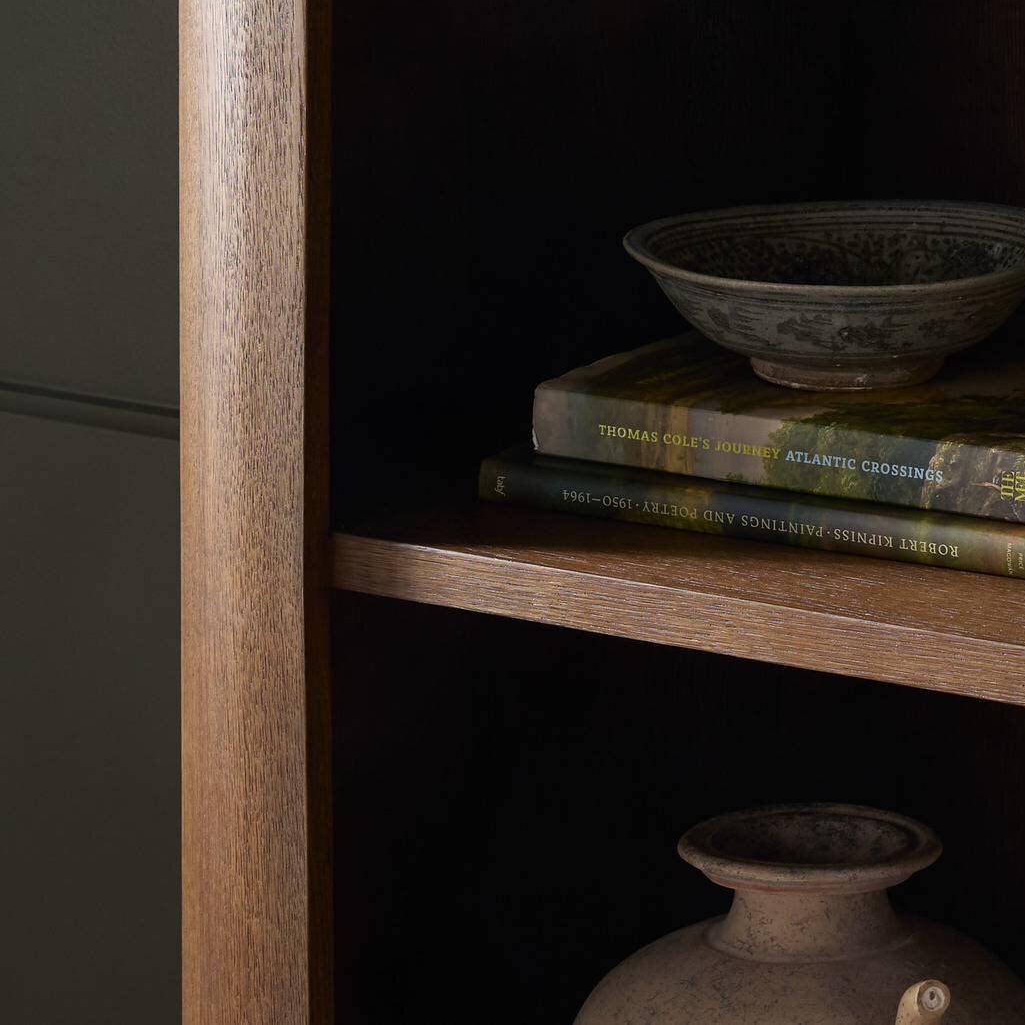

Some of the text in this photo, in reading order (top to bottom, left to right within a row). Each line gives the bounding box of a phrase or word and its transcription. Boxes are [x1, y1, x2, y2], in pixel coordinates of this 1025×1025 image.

[598, 424, 658, 443] THOMAS
[715, 440, 781, 460] JOURNEY
[785, 449, 944, 483] ATLANTIC CROSSINGS
[642, 501, 697, 520] POETRY
[704, 509, 735, 525] AND
[741, 514, 823, 537] PAINTINGS
[834, 528, 893, 549] KIPNISS
[900, 538, 959, 558] ROBERT
